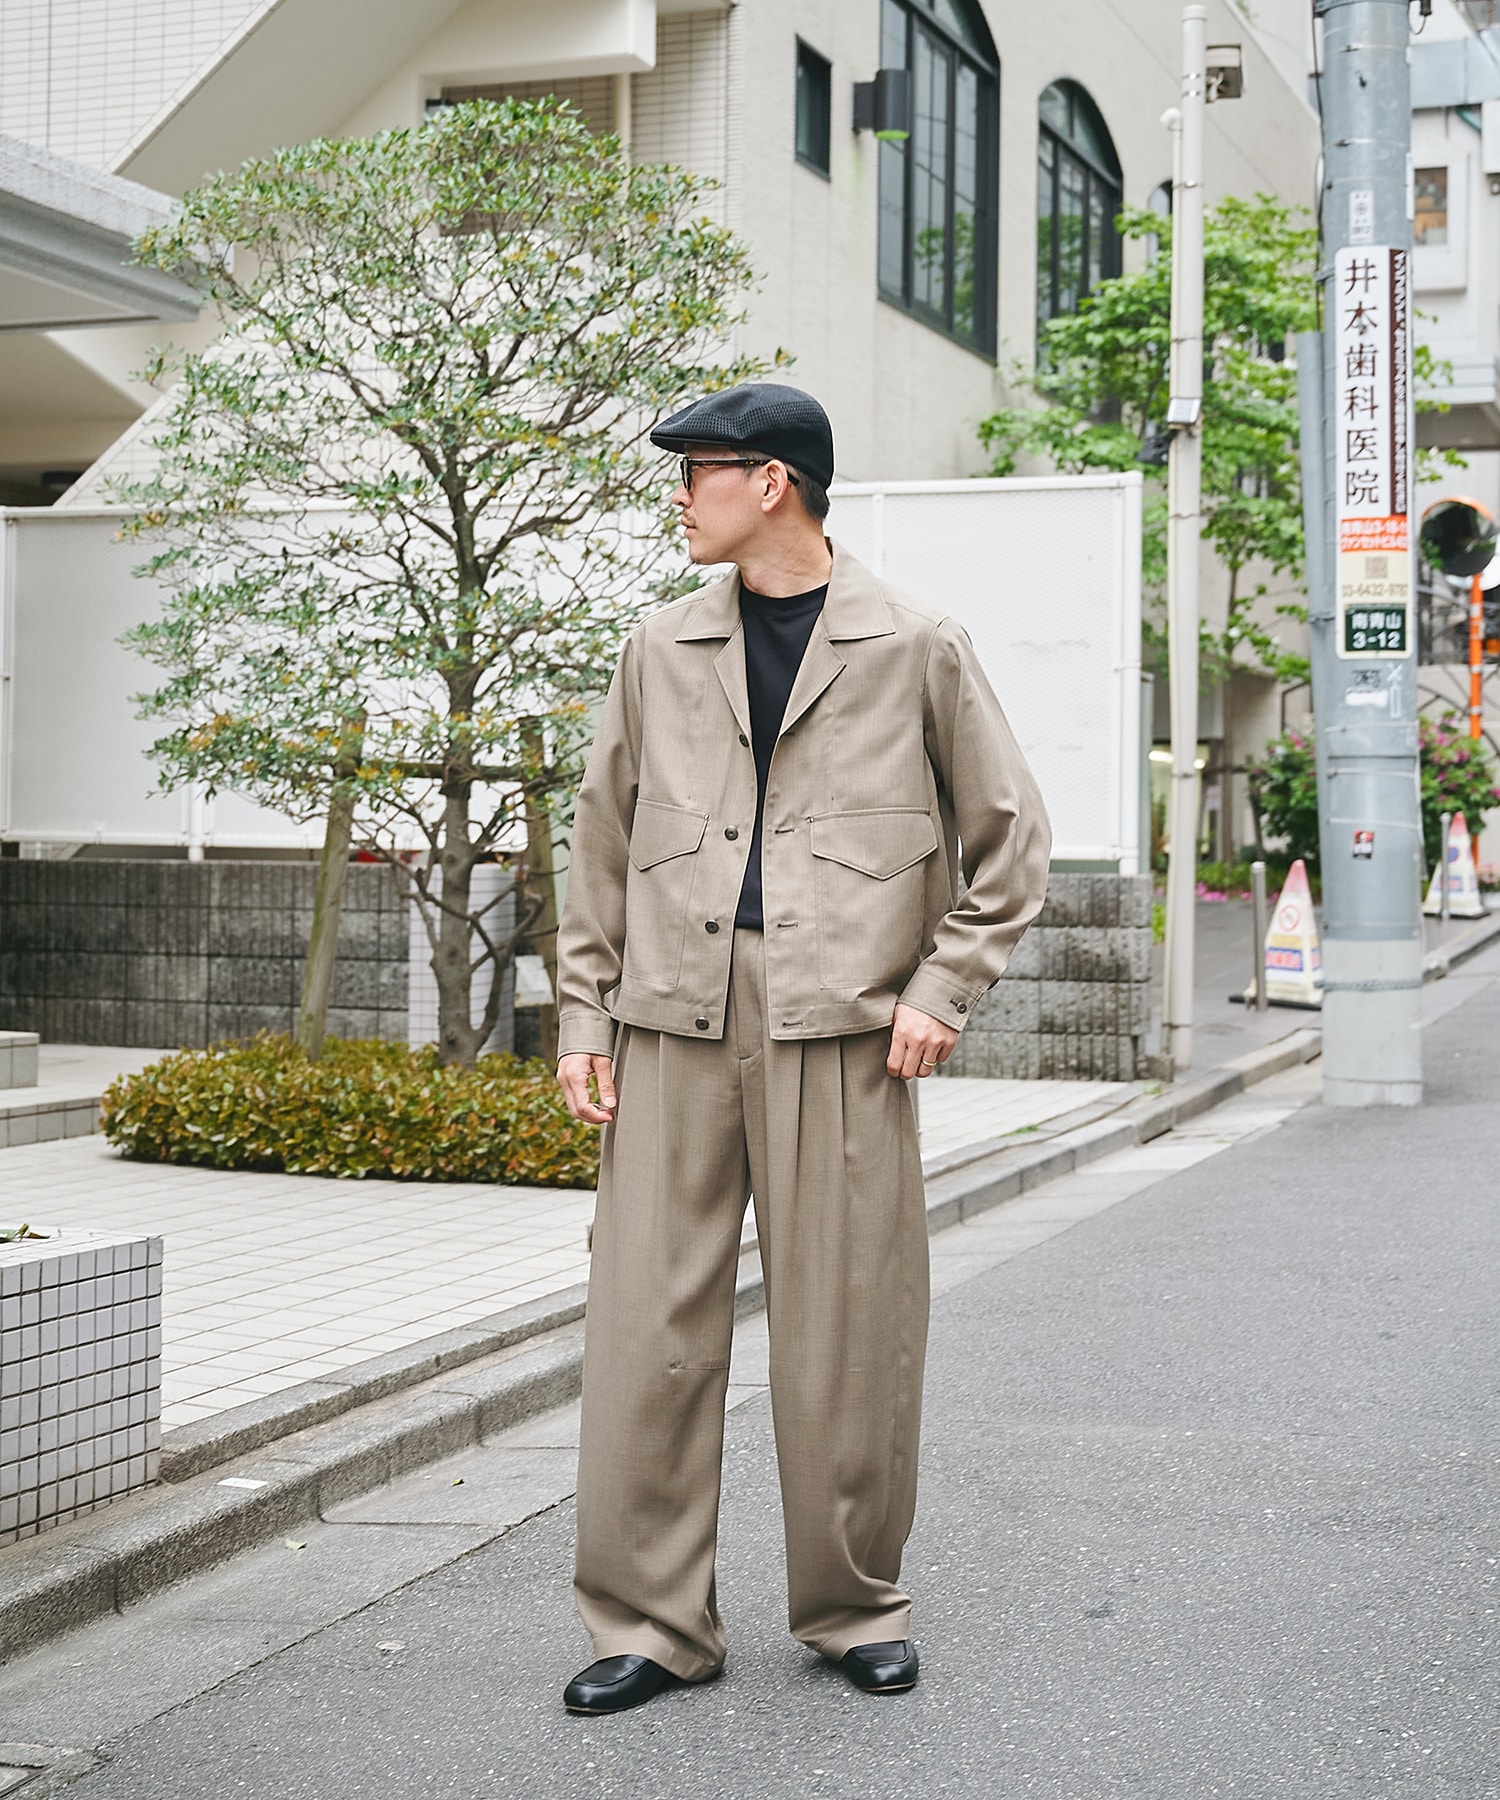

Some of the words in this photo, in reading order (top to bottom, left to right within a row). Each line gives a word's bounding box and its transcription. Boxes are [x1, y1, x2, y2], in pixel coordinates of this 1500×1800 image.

[1344, 257, 1379, 506] 井本歯科医院
[1351, 612, 1402, 629] 南青山
[1352, 631, 1401, 648] 3-12
